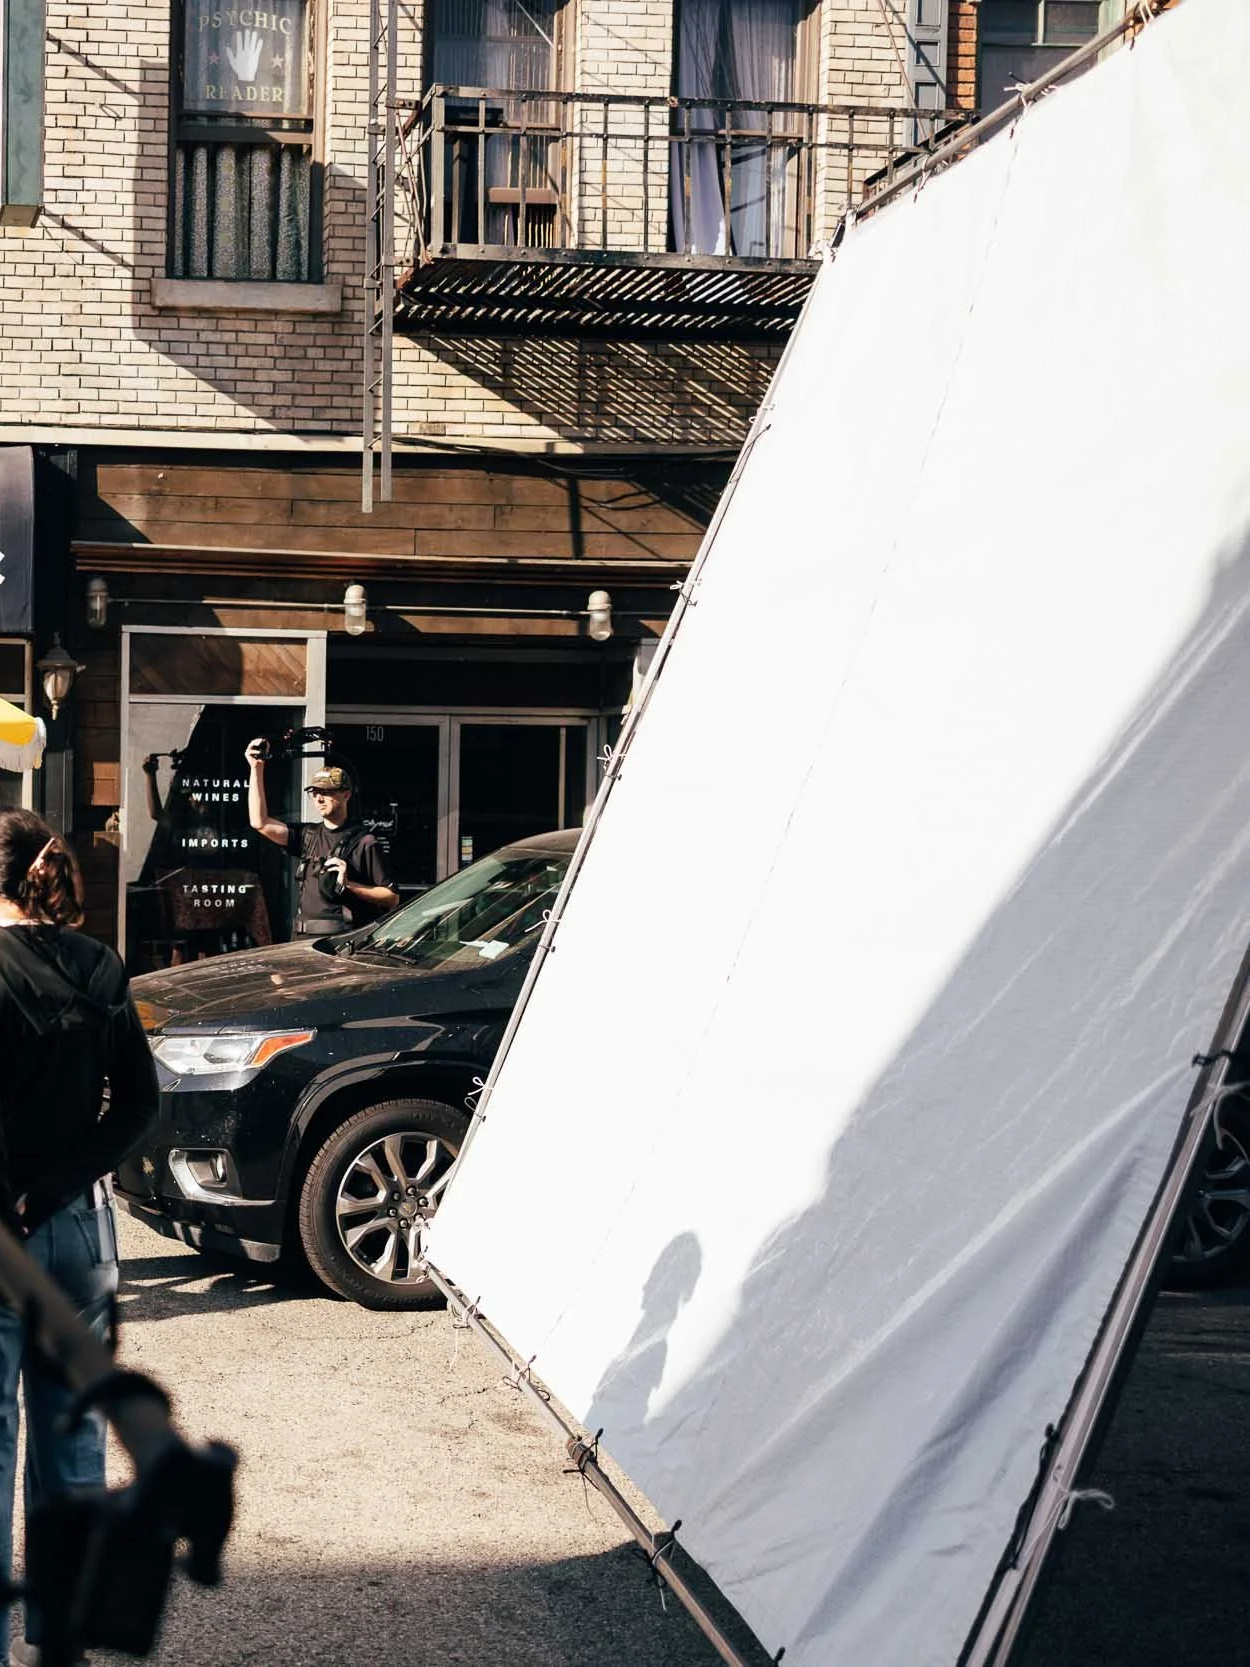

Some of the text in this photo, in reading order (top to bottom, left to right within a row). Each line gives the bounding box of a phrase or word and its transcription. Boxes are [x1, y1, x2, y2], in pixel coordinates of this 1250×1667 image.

[199, 9, 292, 35] PSYCHIC
[206, 85, 283, 102] READER
[366, 726, 384, 741] 150
[182, 779, 250, 788] NATURAL
[191, 793, 240, 802] WINES
[181, 839, 248, 848] IMPORTS
[182, 885, 247, 894] TASTING
[193, 899, 235, 908] ROOM
